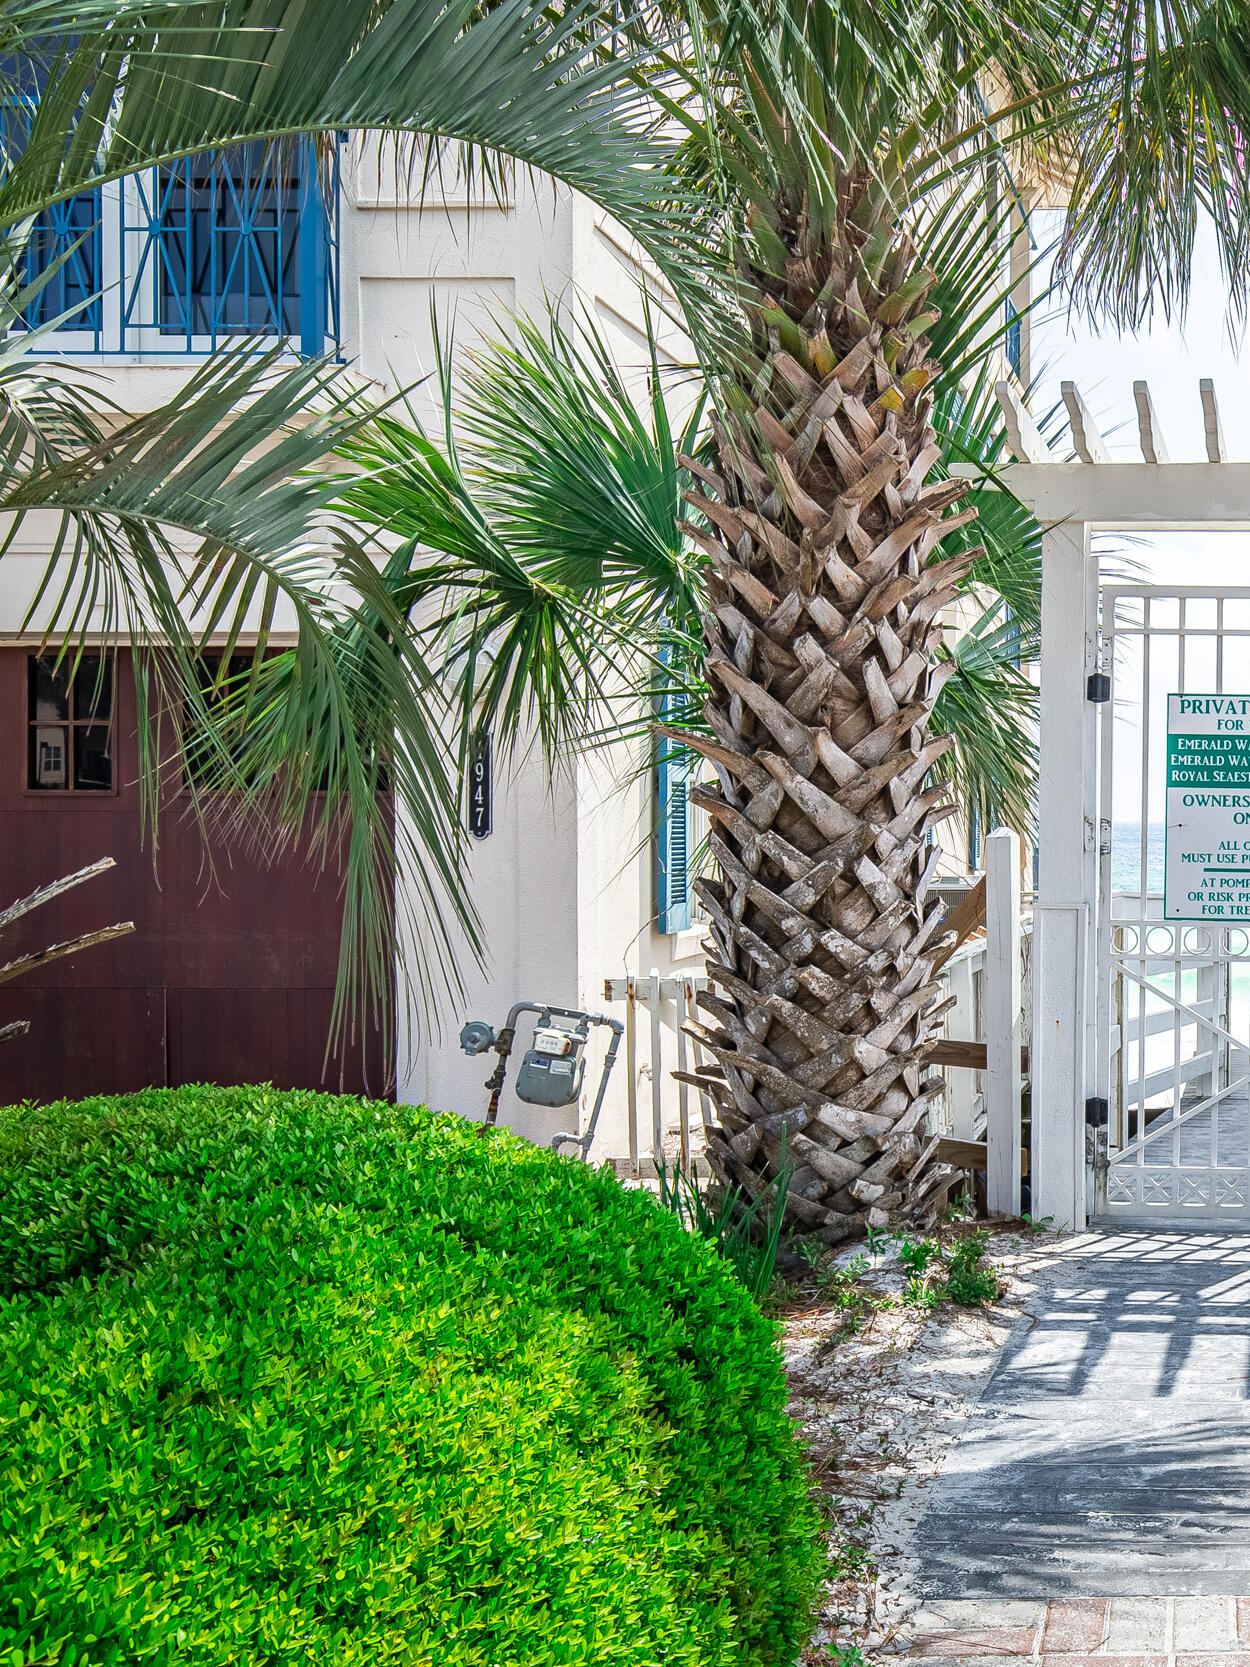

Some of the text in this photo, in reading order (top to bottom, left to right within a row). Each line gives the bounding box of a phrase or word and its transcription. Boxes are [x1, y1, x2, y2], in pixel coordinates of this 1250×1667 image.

[1217, 719, 1244, 730] FOR
[1178, 739, 1232, 750] EMERALD
[1170, 755, 1225, 766] EMERALD
[1171, 771, 1210, 782] ROYAL
[1182, 795, 1250, 808] OWNERS
[1218, 841, 1240, 850] ALL
[1181, 854, 1214, 863] MUST
[1216, 854, 1237, 864] USE
[1200, 878, 1216, 888] AT
[1187, 892, 1204, 901] OR
[1208, 892, 1234, 902] RISK
[1201, 905, 1225, 915] FOR
